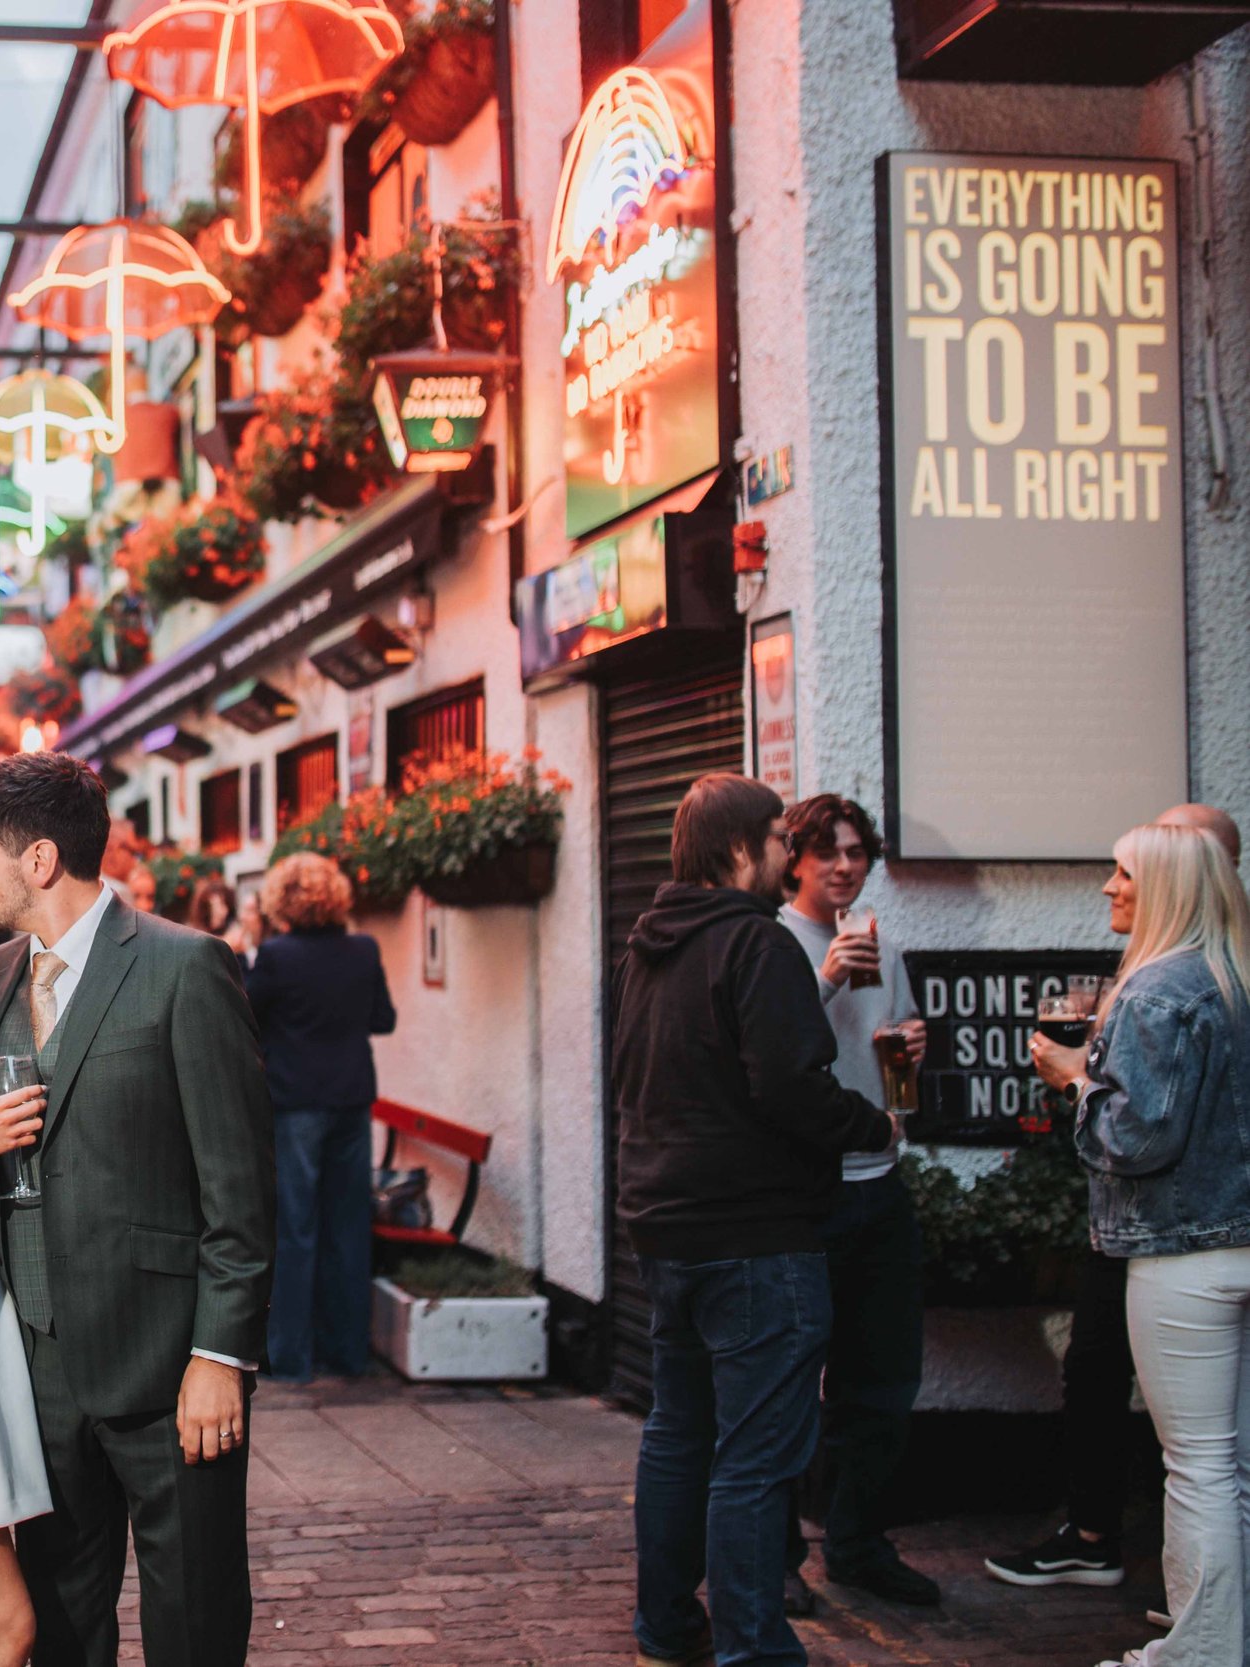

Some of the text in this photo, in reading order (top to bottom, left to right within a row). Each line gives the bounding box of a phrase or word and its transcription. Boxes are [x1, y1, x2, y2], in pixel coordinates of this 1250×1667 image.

[904, 167, 1164, 233] EVERYTHING
[904, 228, 1166, 319] IS GOING
[907, 316, 1168, 447] TO BE
[910, 446, 1168, 522] ALL RIGHT
